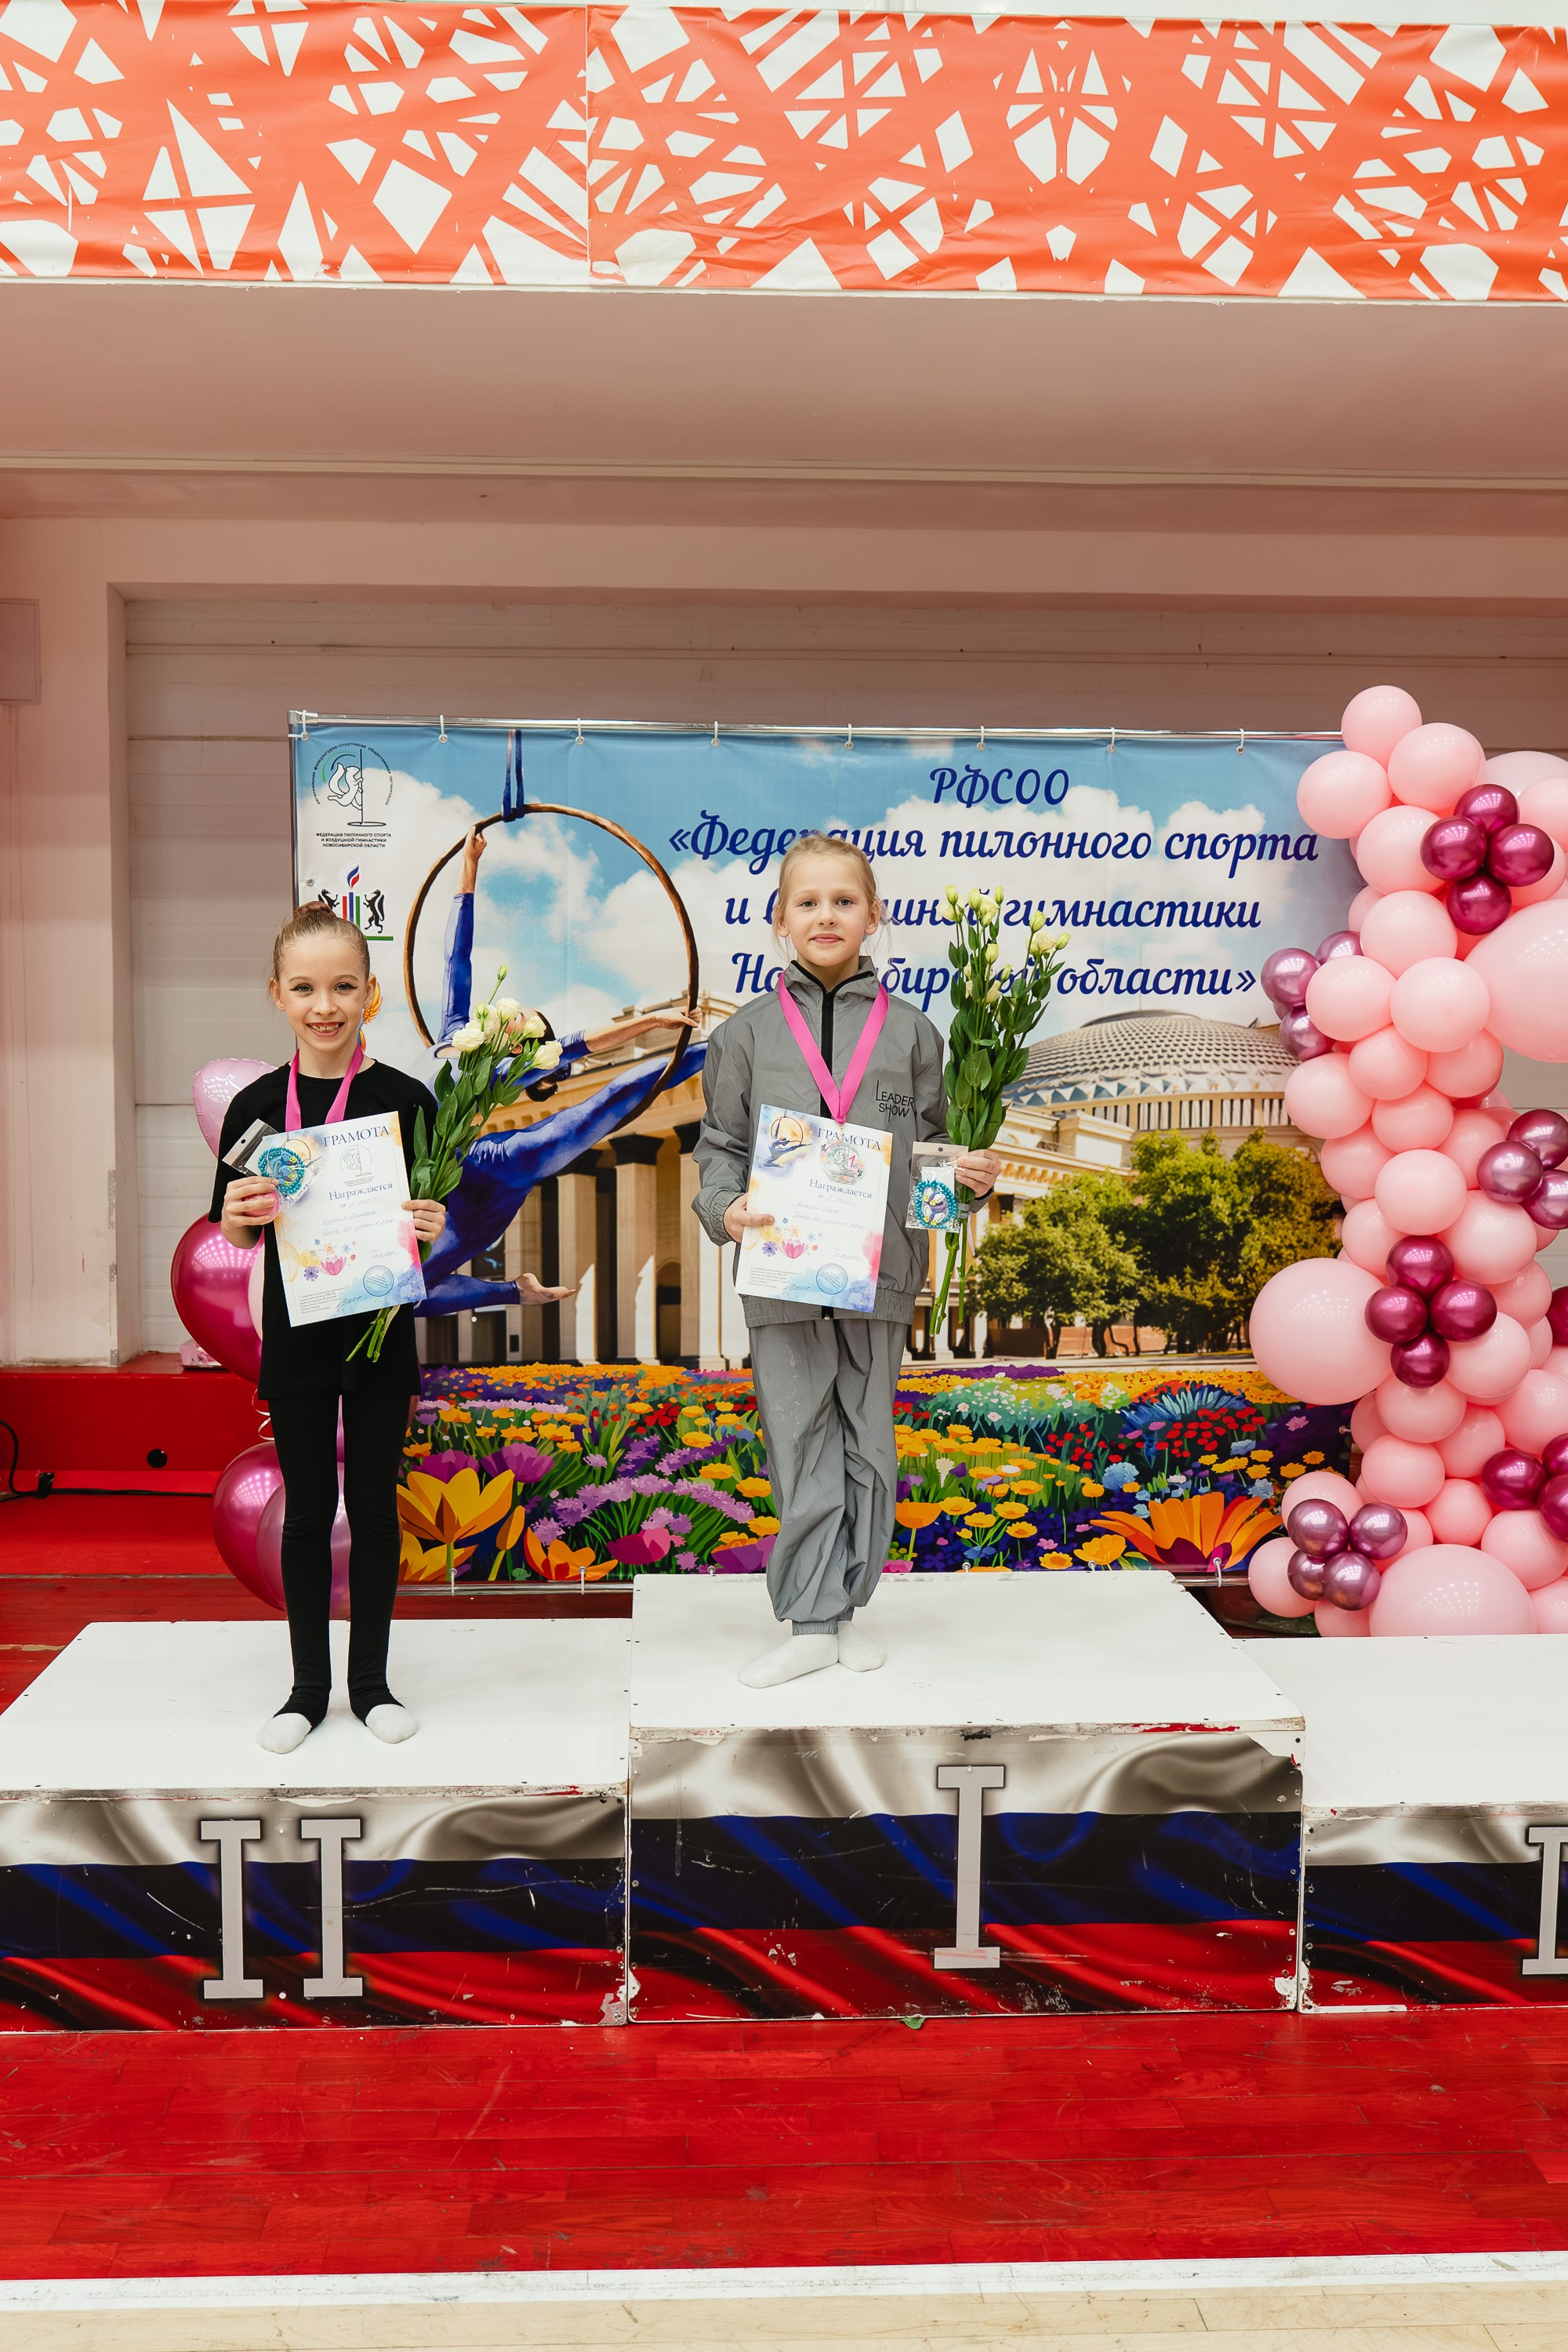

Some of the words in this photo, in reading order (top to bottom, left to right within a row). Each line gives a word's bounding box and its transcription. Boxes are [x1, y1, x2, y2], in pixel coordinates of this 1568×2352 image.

[929, 764, 1069, 808] РФСОО
[668, 809, 927, 875] «Федеция
[939, 830, 1152, 859] пилонного
[1164, 833, 1319, 879] спорта
[725, 898, 751, 925] и
[1004, 899, 1261, 927] гимнастики
[1057, 958, 1256, 996] области»
[875, 1080, 915, 1108] LEADER
[878, 1102, 910, 1123] SHOW
[323, 1125, 390, 1147] ГРАМОТА
[817, 1127, 881, 1151] ГРАМОТА
[328, 1182, 393, 1200] Награждается
[809, 1178, 873, 1200] Награждается
[934, 1766, 1004, 1969] I
[201, 1819, 364, 1999] II
